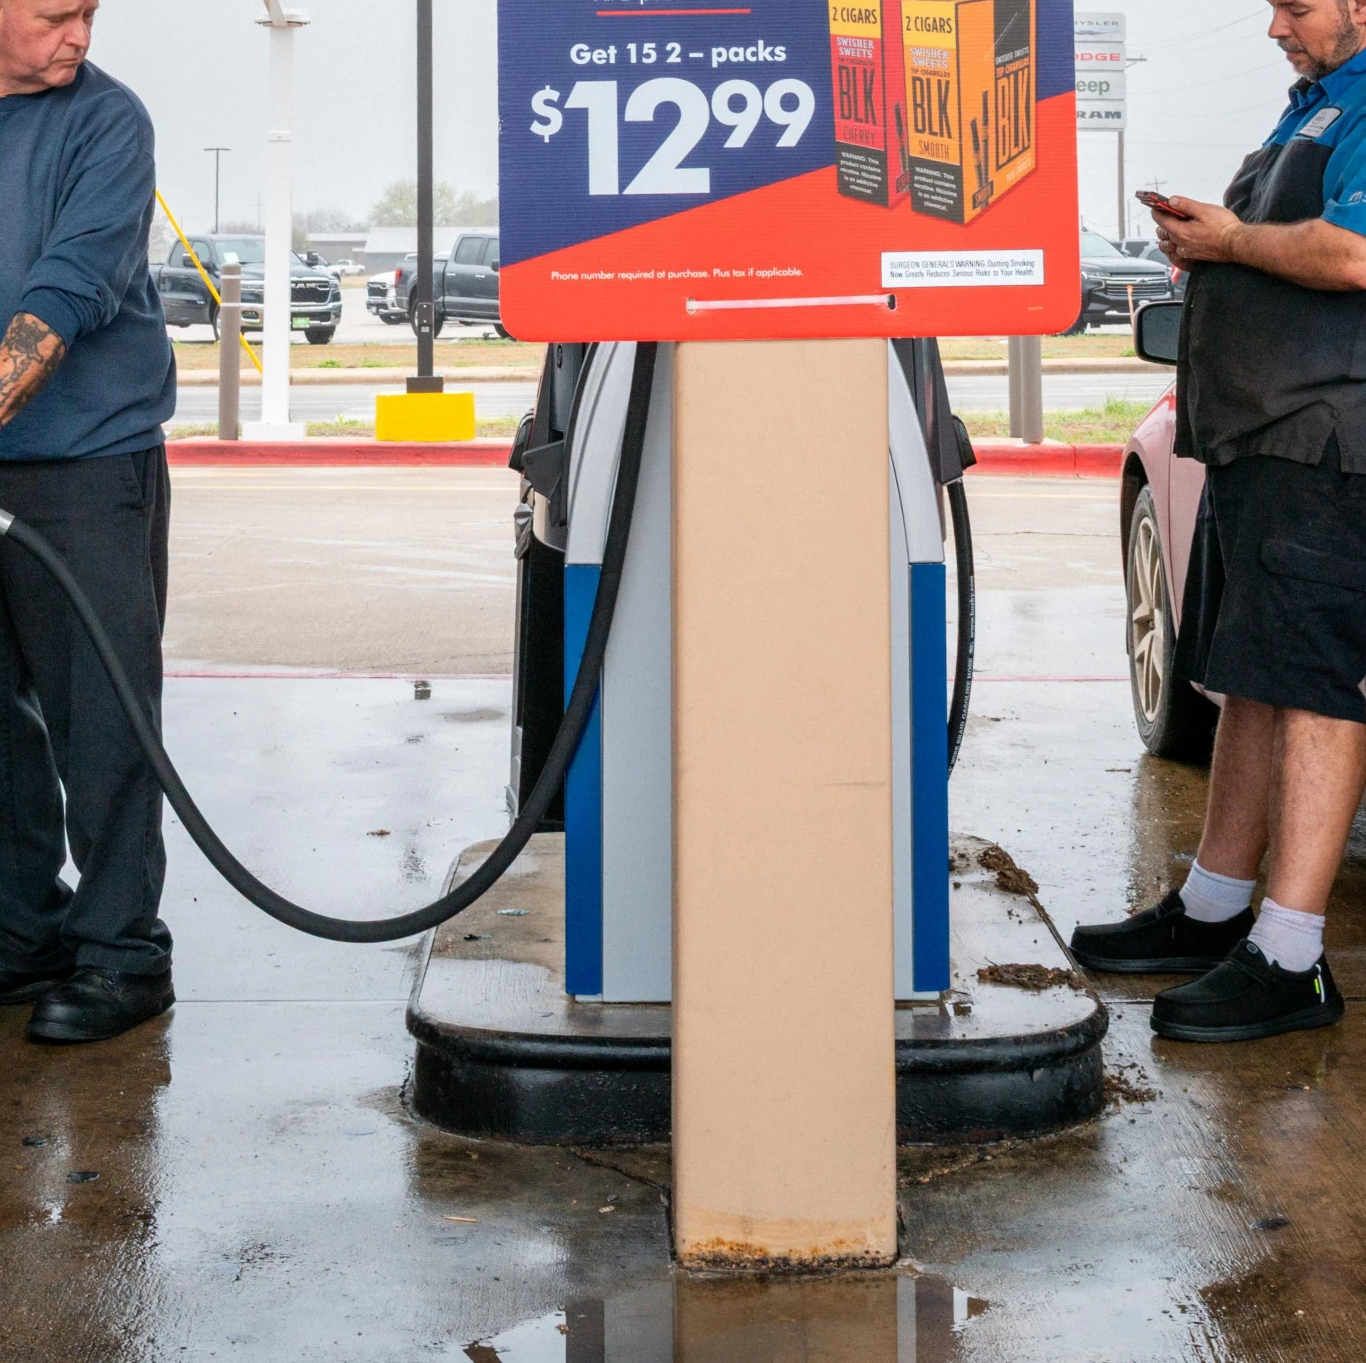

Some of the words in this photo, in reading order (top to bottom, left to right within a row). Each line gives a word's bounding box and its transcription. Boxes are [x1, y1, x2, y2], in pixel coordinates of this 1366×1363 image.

[832, 7, 838, 21] 2
[841, 8, 877, 24] CIGARS
[906, 16, 912, 31] 2
[914, 17, 953, 34] CIGARS
[836, 37, 874, 49] SWISHER
[570, 43, 617, 64] Get
[627, 43, 657, 63] 15
[665, 42, 682, 63] 2
[711, 40, 787, 68] packs
[839, 46, 873, 59] SWEETS
[910, 47, 949, 59] SWISHER
[1074, 53, 1121, 61] DGE
[913, 57, 948, 69] SWEETS
[838, 65, 877, 125] BLK
[1076, 80, 1110, 95] eep
[912, 76, 952, 139] BLK
[997, 68, 1030, 167] BLK
[843, 125, 876, 145] CHERRY
[919, 140, 950, 160] SMOOTH
[890, 261, 920, 269] SURGEON
[921, 260, 954, 268] GENERAL'S
[987, 260, 1009, 269] Quitting
[1010, 259, 1035, 269] Smoking
[551, 271, 578, 280] Phone
[581, 271, 614, 280] number
[617, 269, 654, 281] required
[657, 271, 666, 279] at
[668, 269, 711, 280] purchase.
[713, 269, 730, 278] Plus
[732, 269, 746, 278] tax
[748, 268, 754, 277] if
[756, 267, 804, 279] applicable.
[905, 270, 924, 279] Greatly
[952, 269, 974, 277] Serious
[976, 269, 991, 277] Risks
[957, 722, 965, 744] BRAID
[961, 681, 971, 720] GASOLINE
